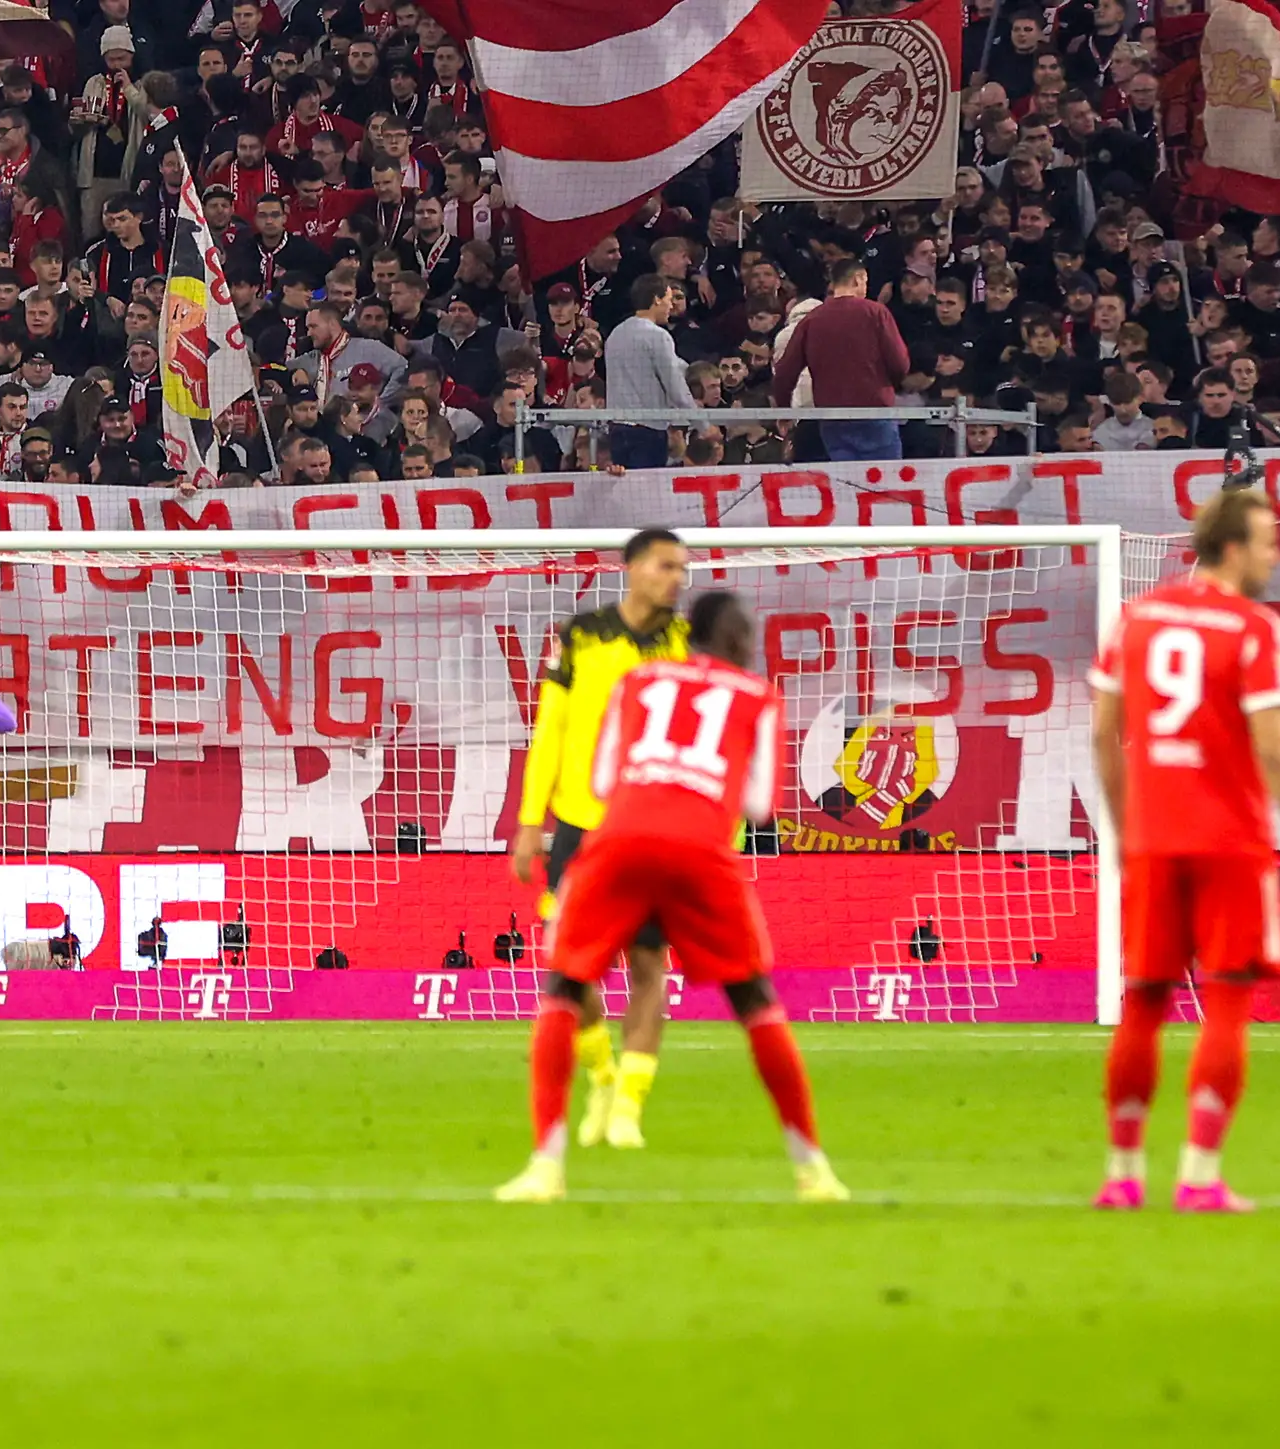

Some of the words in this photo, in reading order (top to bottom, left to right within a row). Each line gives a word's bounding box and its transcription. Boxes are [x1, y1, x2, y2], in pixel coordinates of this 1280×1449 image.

[768, 112, 793, 142] FC
[783, 142, 862, 187] BAYERN
[869, 109, 934, 182] ULTRAS
[672, 459, 1104, 581] TRÄGT
[627, 677, 728, 775] 11
[1145, 625, 1205, 735] 9
